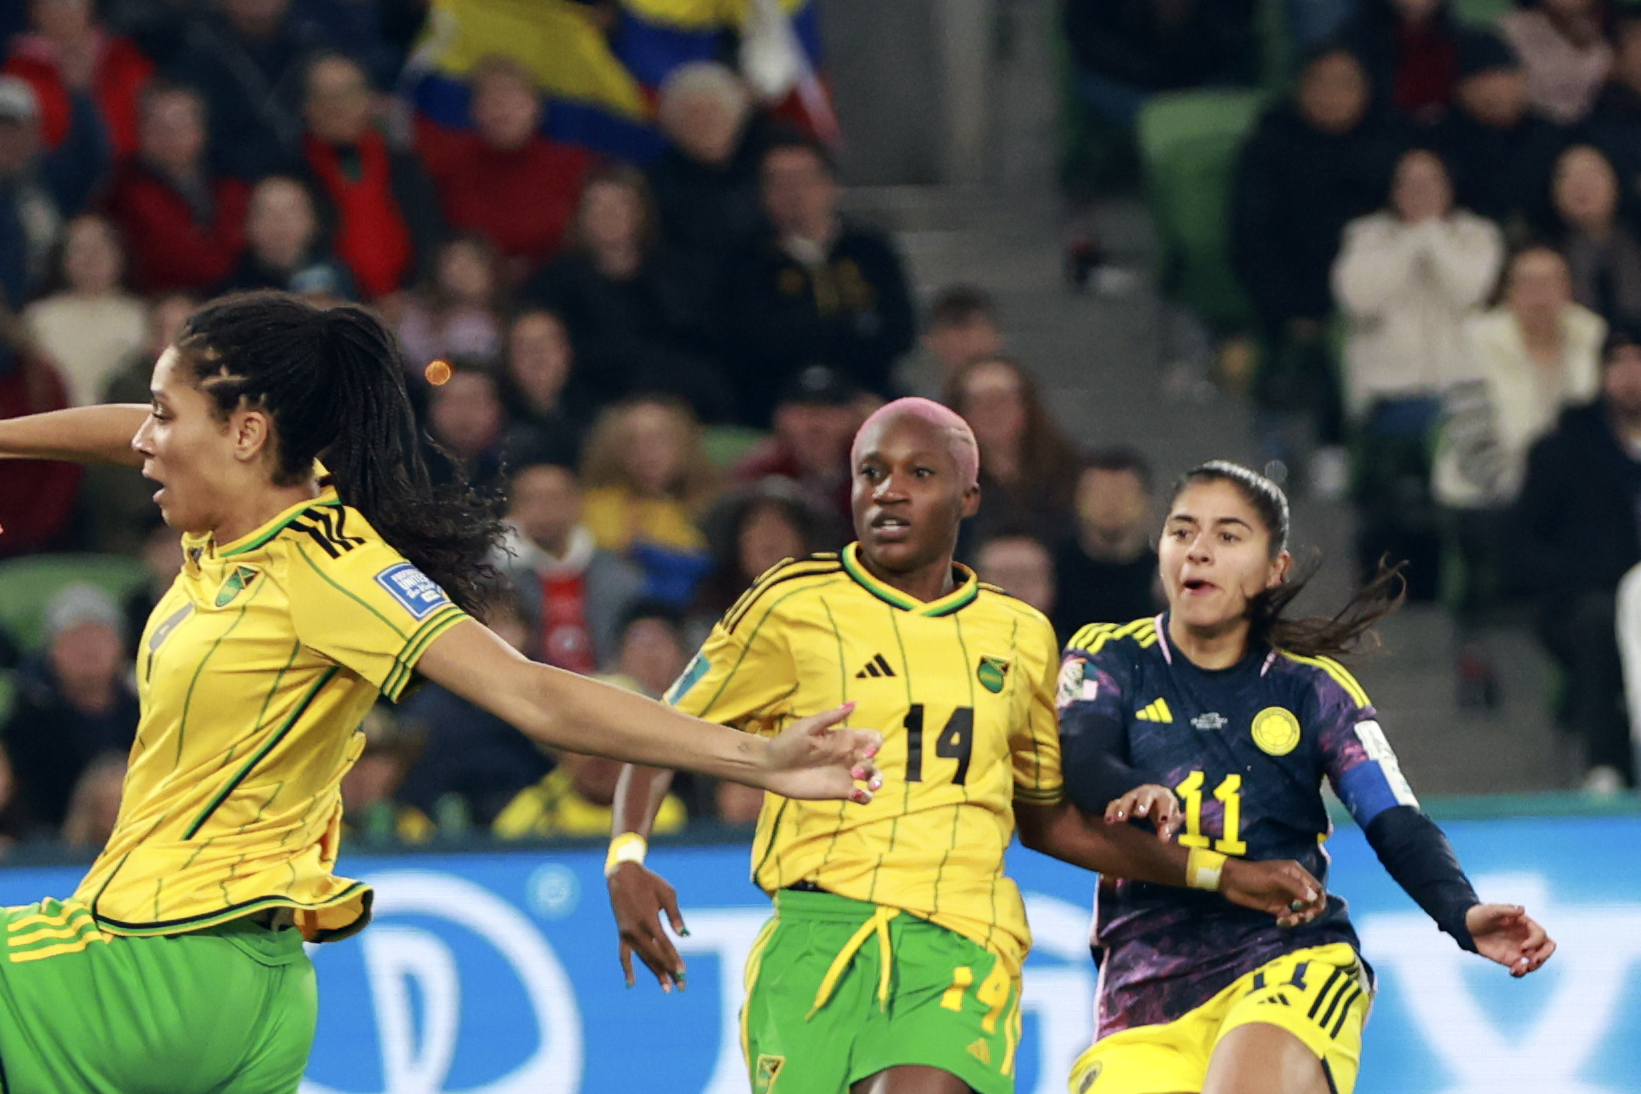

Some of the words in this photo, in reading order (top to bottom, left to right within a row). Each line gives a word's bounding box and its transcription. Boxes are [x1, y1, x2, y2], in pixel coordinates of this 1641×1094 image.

[903, 703, 974, 786] 14
[1175, 770, 1247, 856] 11
[940, 956, 1012, 1035] 14
